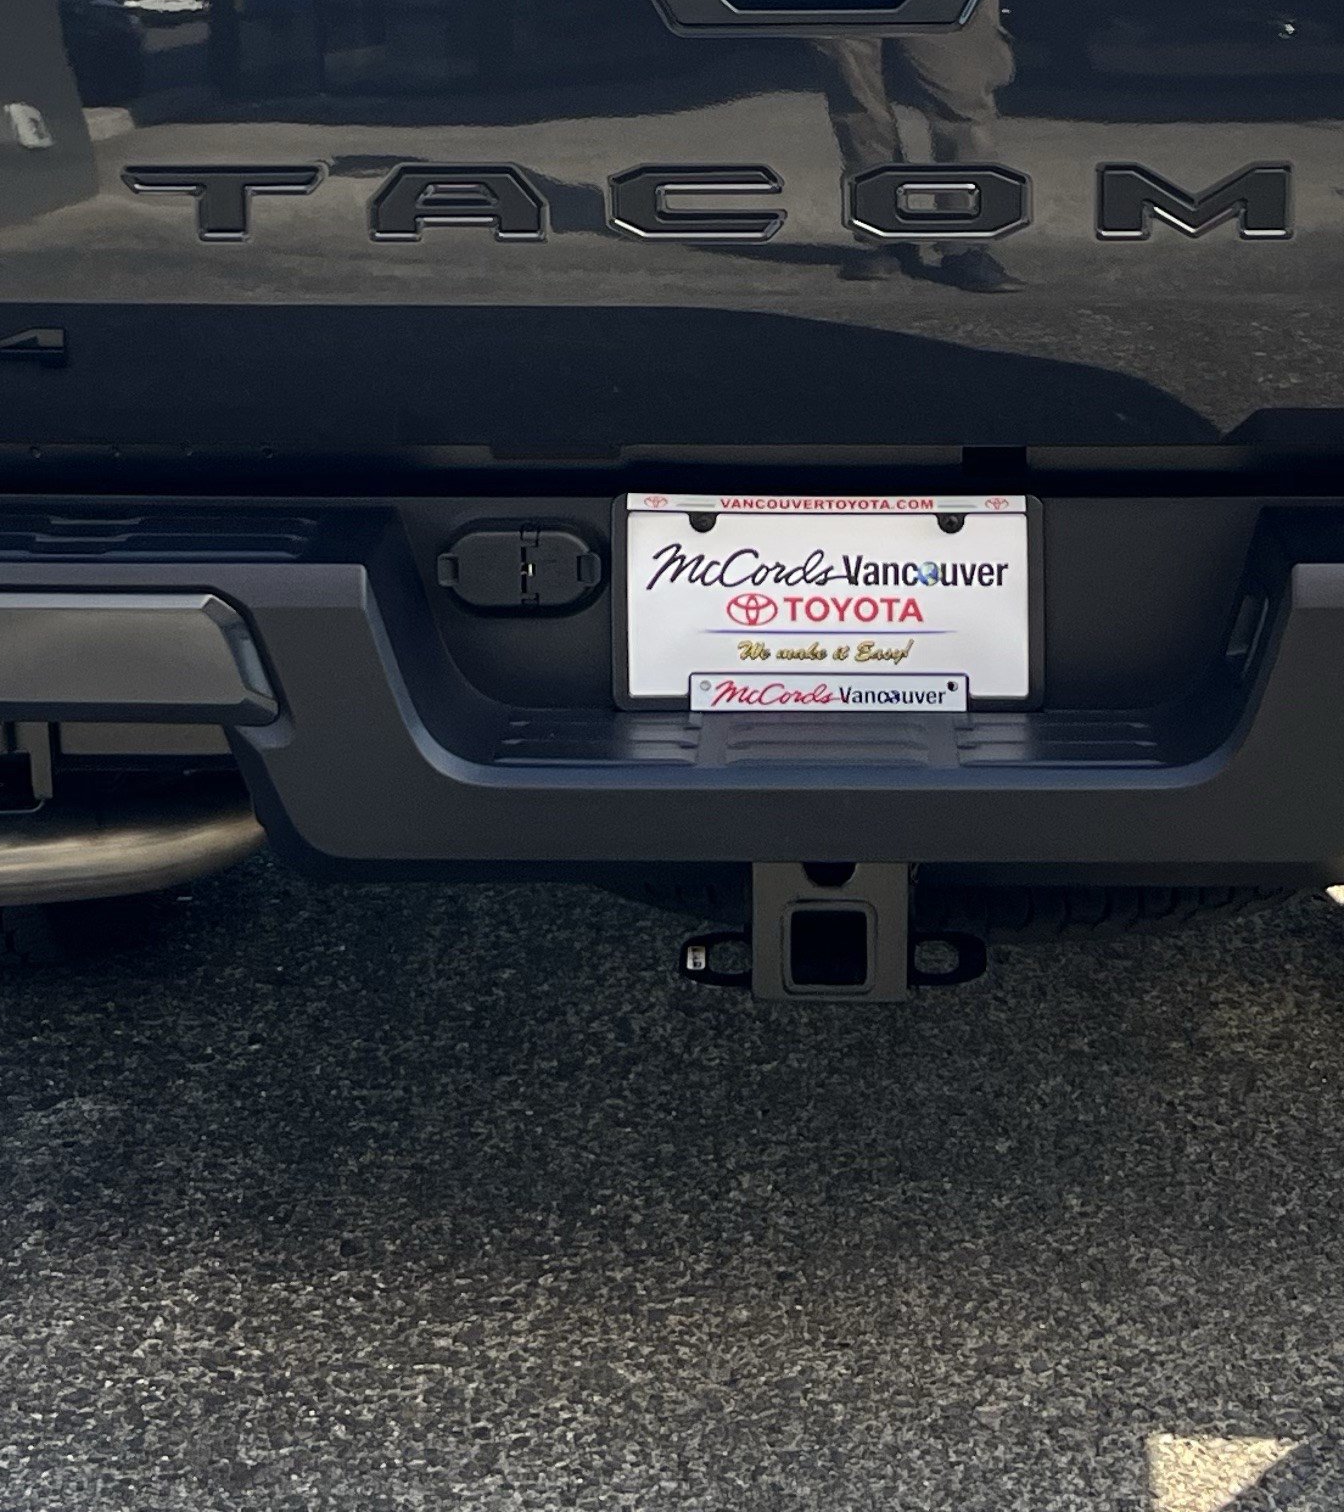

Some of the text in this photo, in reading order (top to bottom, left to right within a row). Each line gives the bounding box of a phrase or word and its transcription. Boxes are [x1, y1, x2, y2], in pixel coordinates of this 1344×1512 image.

[719, 498, 934, 511] VANCOUVERTOYOTA.COM
[783, 596, 924, 623] TOYOTA
[737, 638, 915, 665] We make it Easy!
